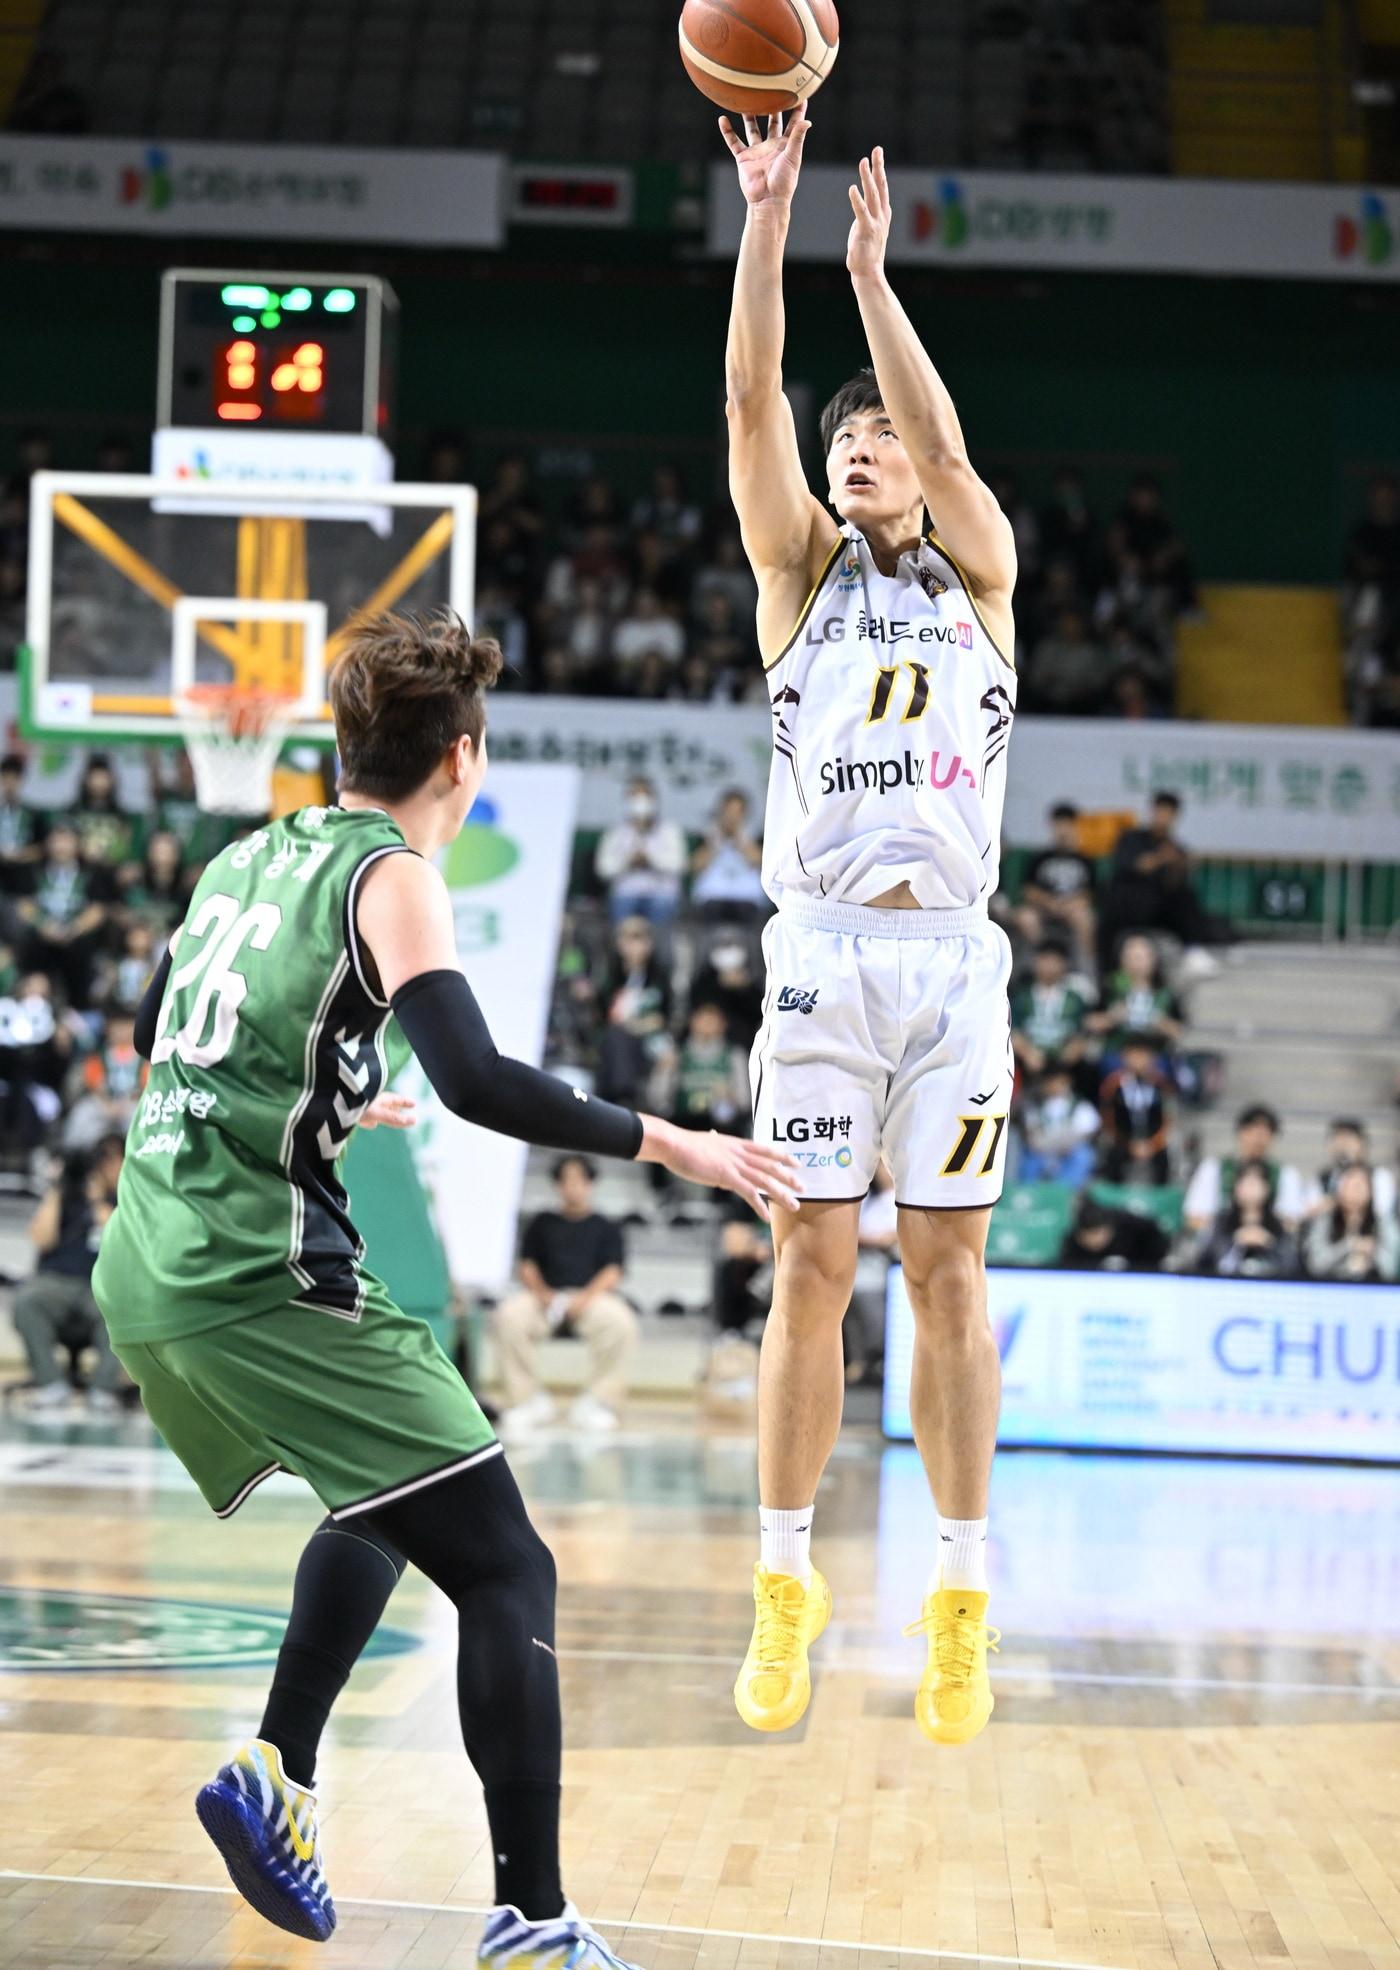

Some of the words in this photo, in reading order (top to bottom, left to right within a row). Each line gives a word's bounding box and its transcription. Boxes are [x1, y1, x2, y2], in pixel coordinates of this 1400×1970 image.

[806, 616, 846, 646] LG
[864, 661, 933, 728] 11
[151, 893, 283, 1069] 26
[772, 1117, 809, 1142] LG
[813, 1116, 853, 1141] 화학
[937, 1112, 1008, 1178] 11
[1213, 1316, 1400, 1384] CHU
